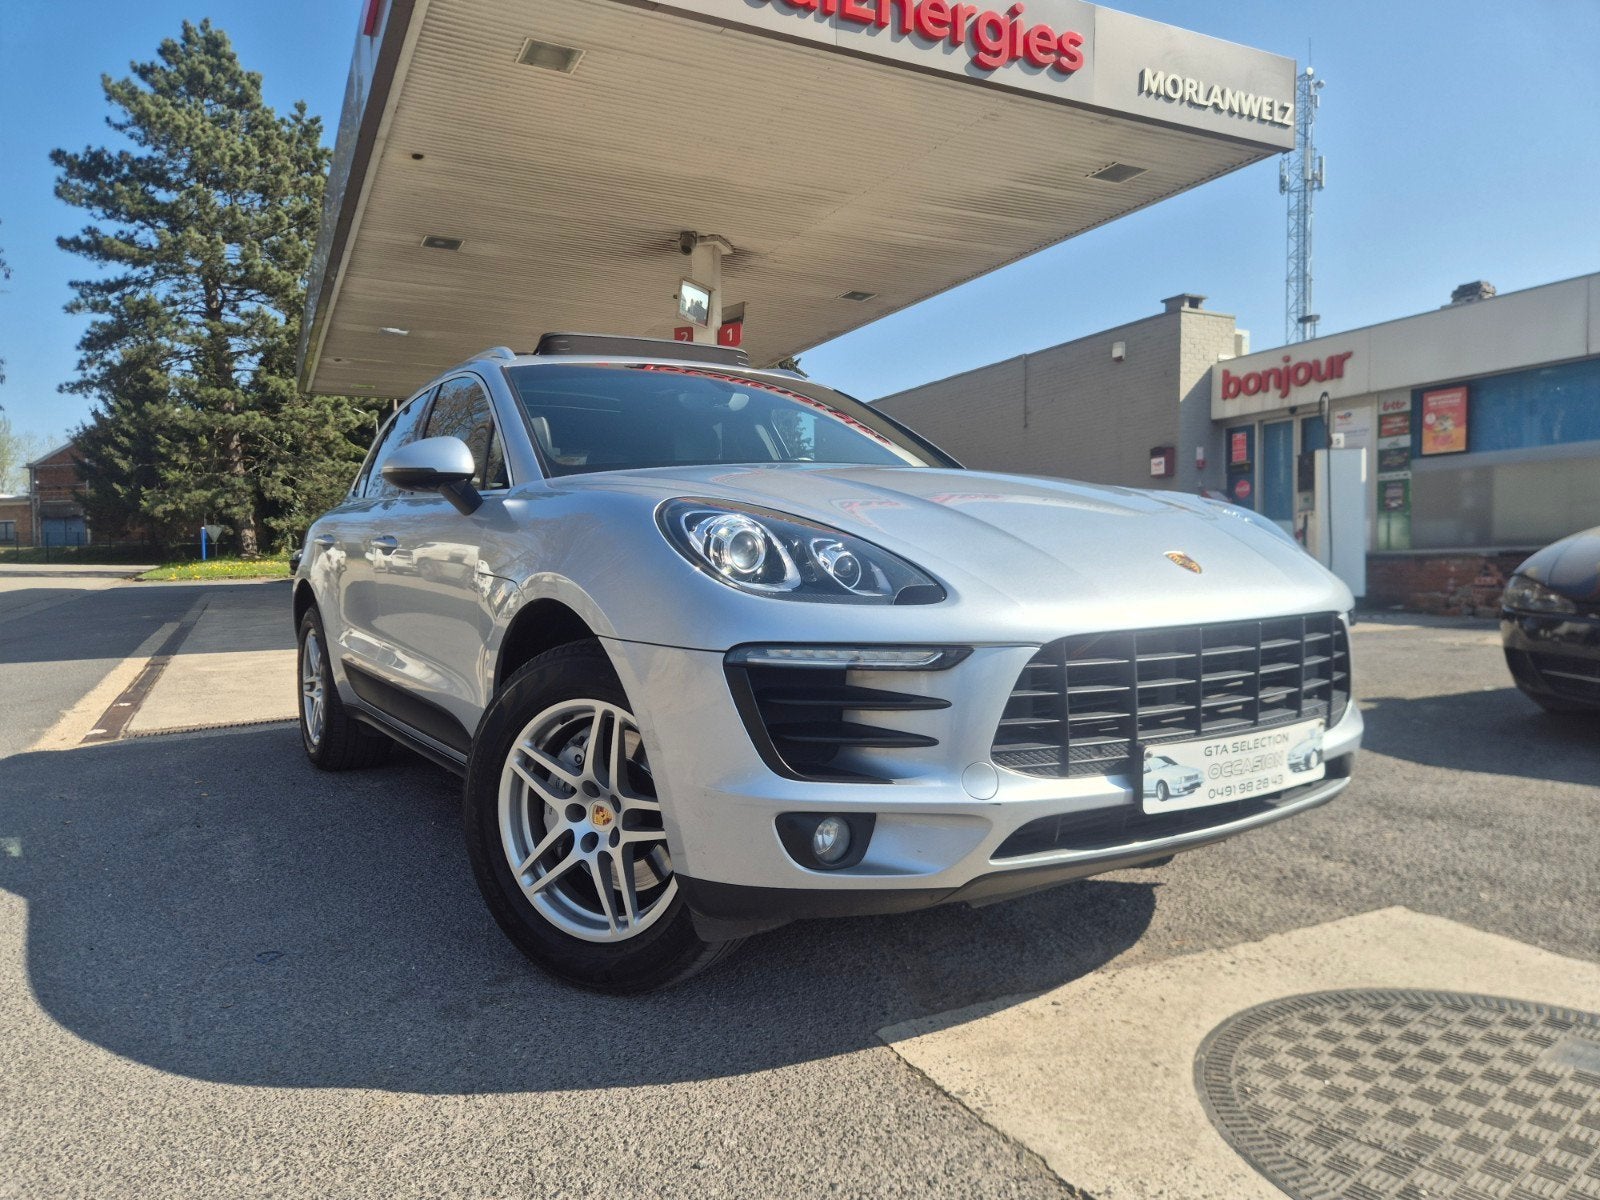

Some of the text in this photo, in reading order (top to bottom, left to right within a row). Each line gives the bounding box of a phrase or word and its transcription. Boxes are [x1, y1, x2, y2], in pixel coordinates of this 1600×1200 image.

[1141, 67, 1295, 127] MORLANWELZ
[727, 328, 733, 341] 1
[1221, 351, 1353, 400] bonjour
[1204, 733, 1288, 756] GTA SELECTION
[1208, 751, 1284, 779] OCCASION
[1208, 774, 1283, 798] 0491 98 28 43
